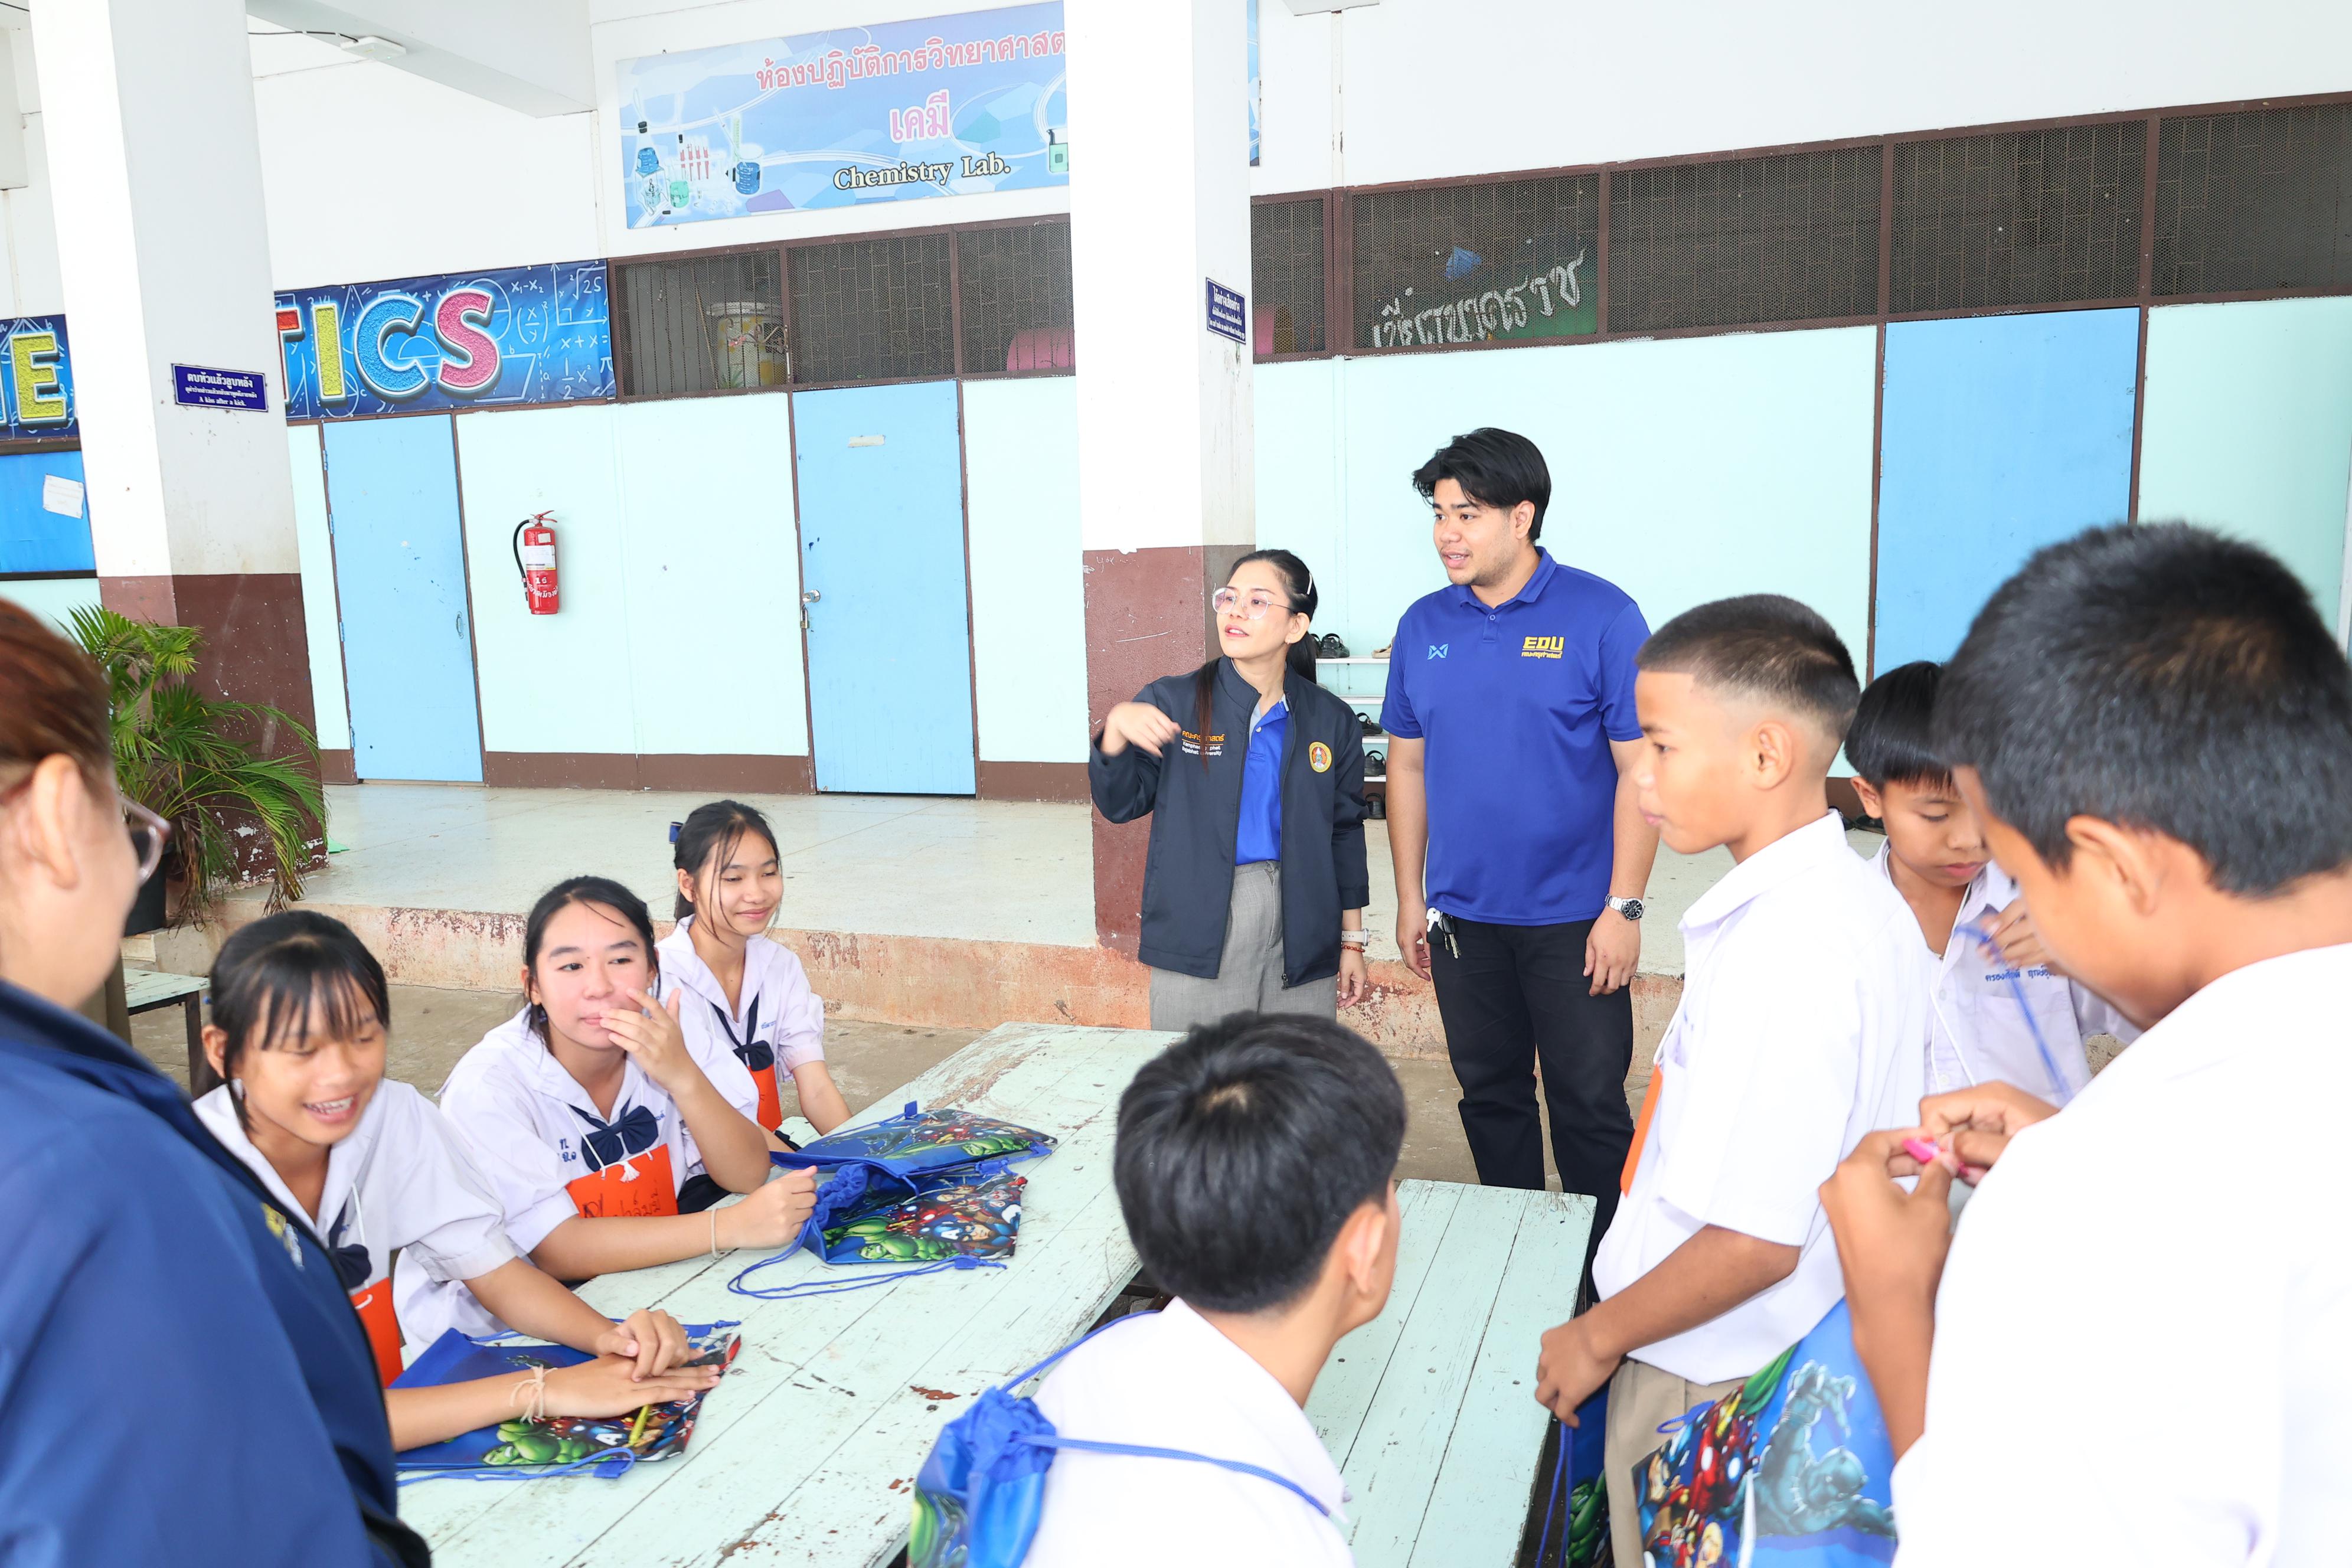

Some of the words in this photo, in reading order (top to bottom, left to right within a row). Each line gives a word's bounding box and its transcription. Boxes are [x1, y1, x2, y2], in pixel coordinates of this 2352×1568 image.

[891, 92, 949, 141] เคมี
[834, 162, 953, 190] Chemistry
[962, 151, 1011, 177] Lab.
[0, 331, 68, 424] E
[1523, 636, 1564, 651] EDU
